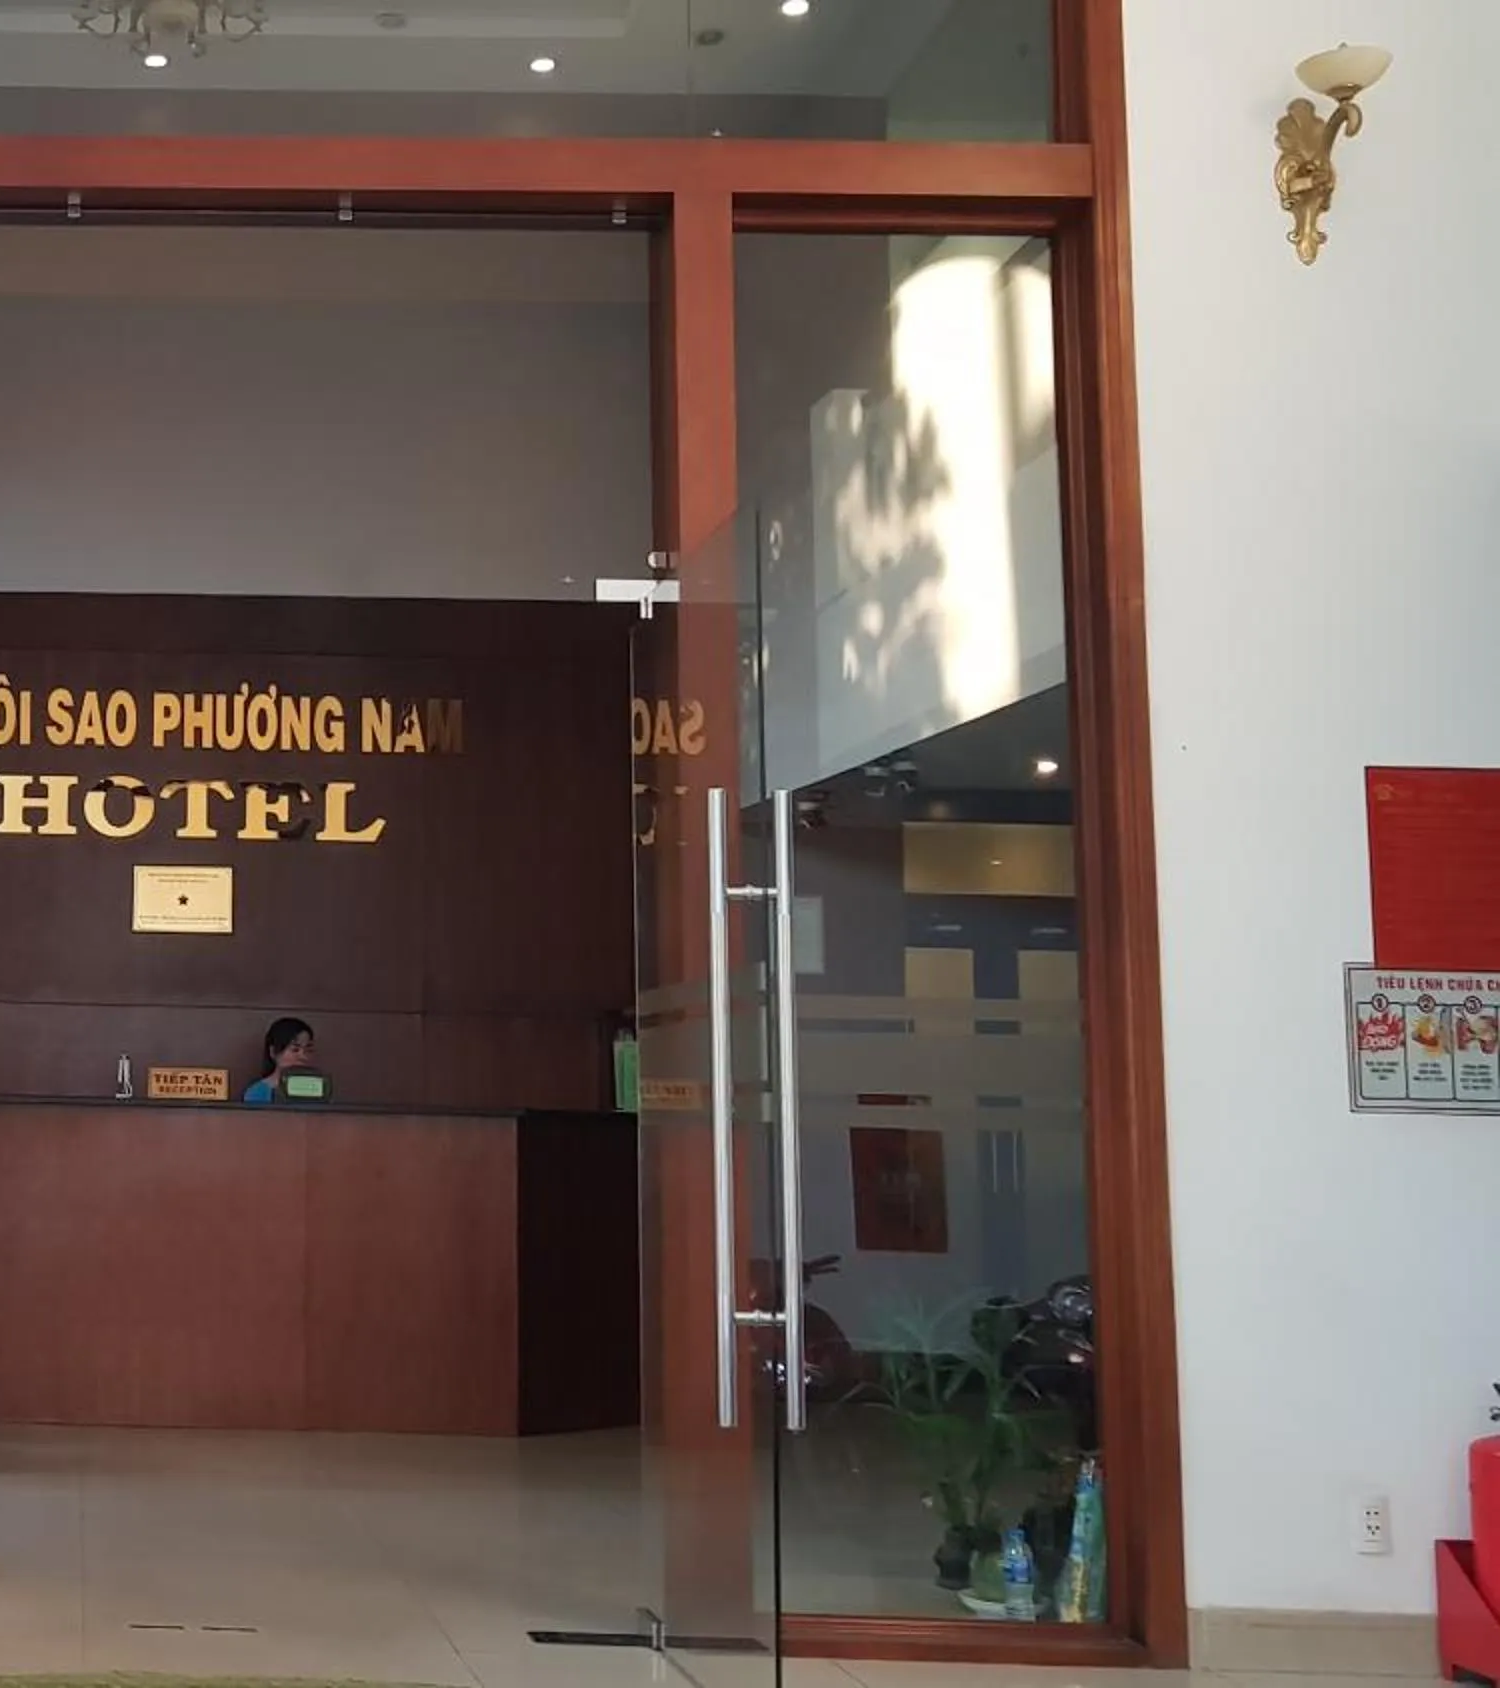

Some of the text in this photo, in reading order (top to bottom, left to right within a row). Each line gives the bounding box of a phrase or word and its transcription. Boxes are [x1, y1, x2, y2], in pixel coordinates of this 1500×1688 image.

[45, 687, 138, 747] SAO
[152, 682, 346, 752] PHƯƠNG
[361, 697, 465, 753] NAM
[192, 1073, 223, 1085] TÂN
[158, 1085, 217, 1095] RECEPTION
